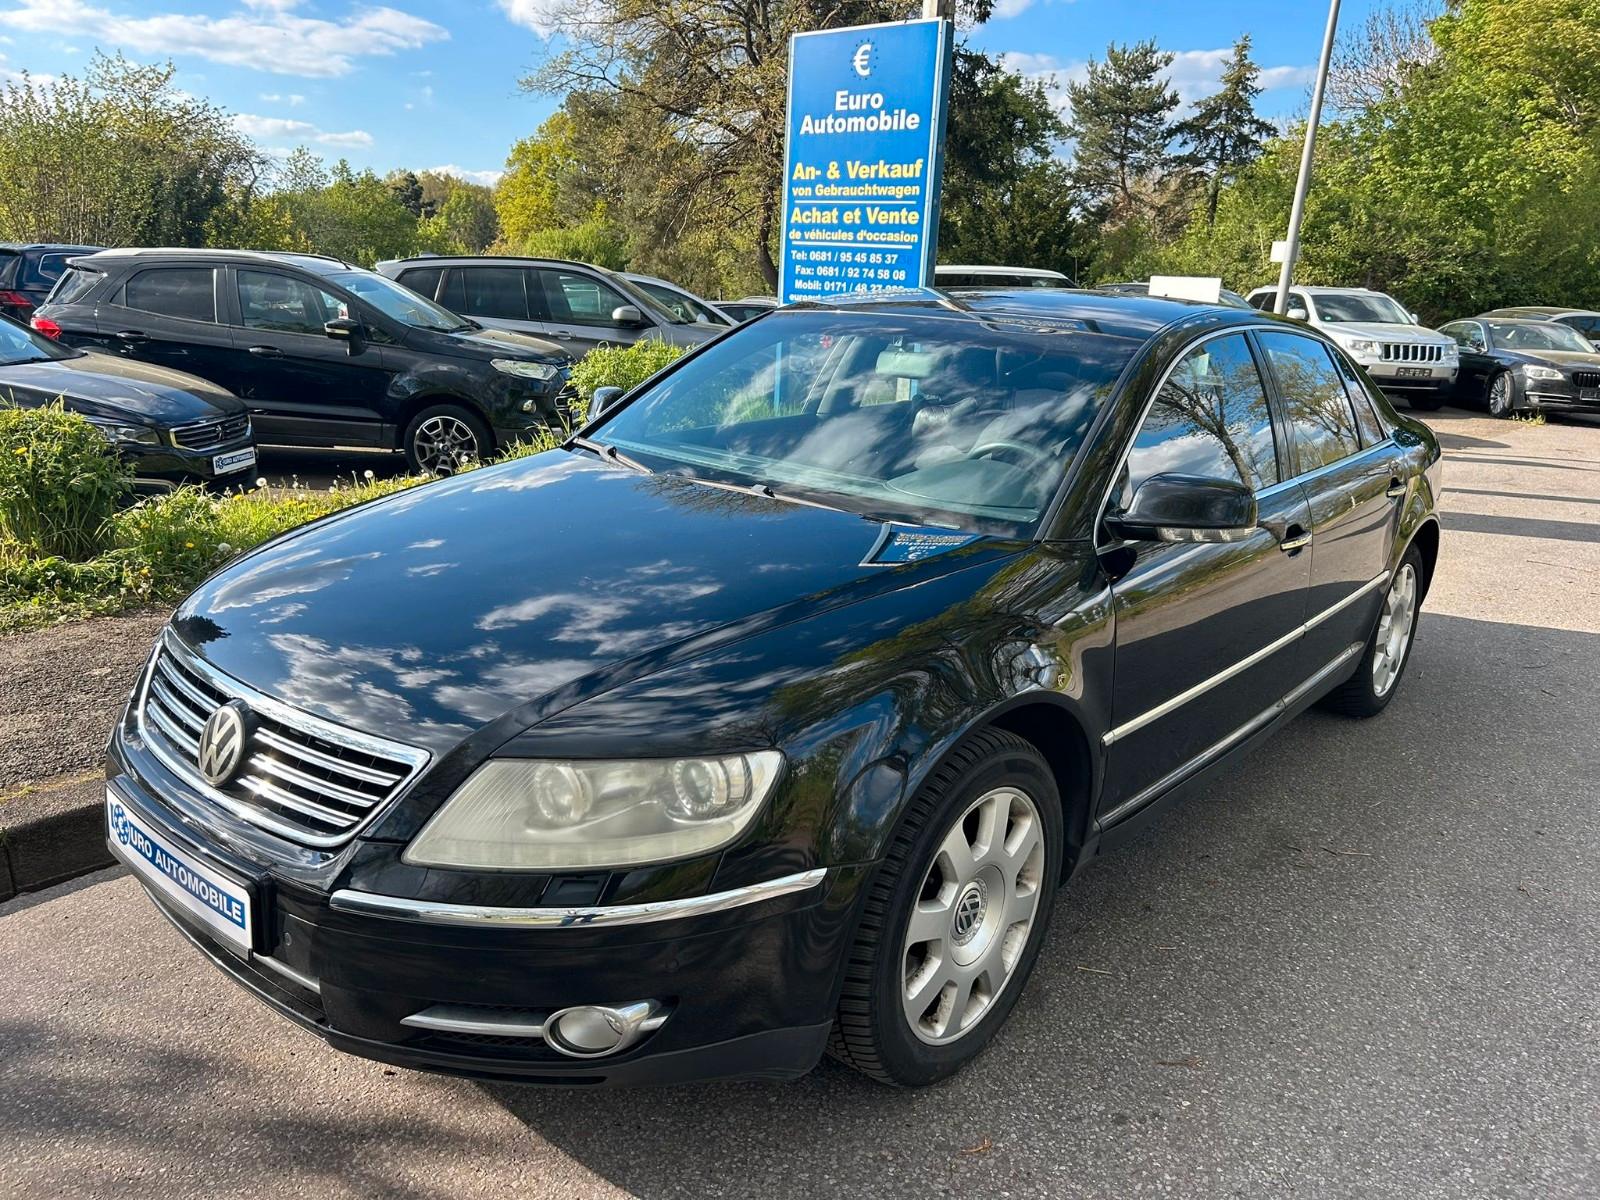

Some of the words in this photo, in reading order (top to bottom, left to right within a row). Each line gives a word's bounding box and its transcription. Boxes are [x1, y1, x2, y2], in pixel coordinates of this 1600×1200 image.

[835, 90, 884, 111] Euro
[800, 109, 920, 135] Automobile
[792, 162, 822, 180] An-
[826, 161, 840, 180] &
[846, 158, 924, 179] Verkauf
[792, 187, 811, 196] von
[815, 183, 920, 198] Gebrauchtwagen
[790, 207, 838, 224] Achat
[843, 208, 861, 224] et
[866, 207, 920, 225] Vente
[789, 229, 801, 239] de
[804, 229, 854, 240] véhicules
[857, 230, 918, 243] d'occasion
[791, 250, 807, 260] Tel:
[809, 250, 832, 261] 0681
[834, 252, 839, 262] /
[840, 251, 852, 262] 95
[854, 253, 867, 263] 45
[869, 254, 882, 264] 85
[884, 254, 898, 264] 37
[795, 265, 814, 276] Fax:
[816, 266, 839, 277] 0681
[841, 268, 845, 277] /
[847, 267, 859, 278] 92
[863, 268, 875, 279] 74
[877, 269, 890, 280] 58
[892, 270, 906, 281] 08
[794, 279, 821, 290] Mobil:
[823, 281, 847, 292] 0171
[155, 852, 242, 924] AUTOMOBILE
